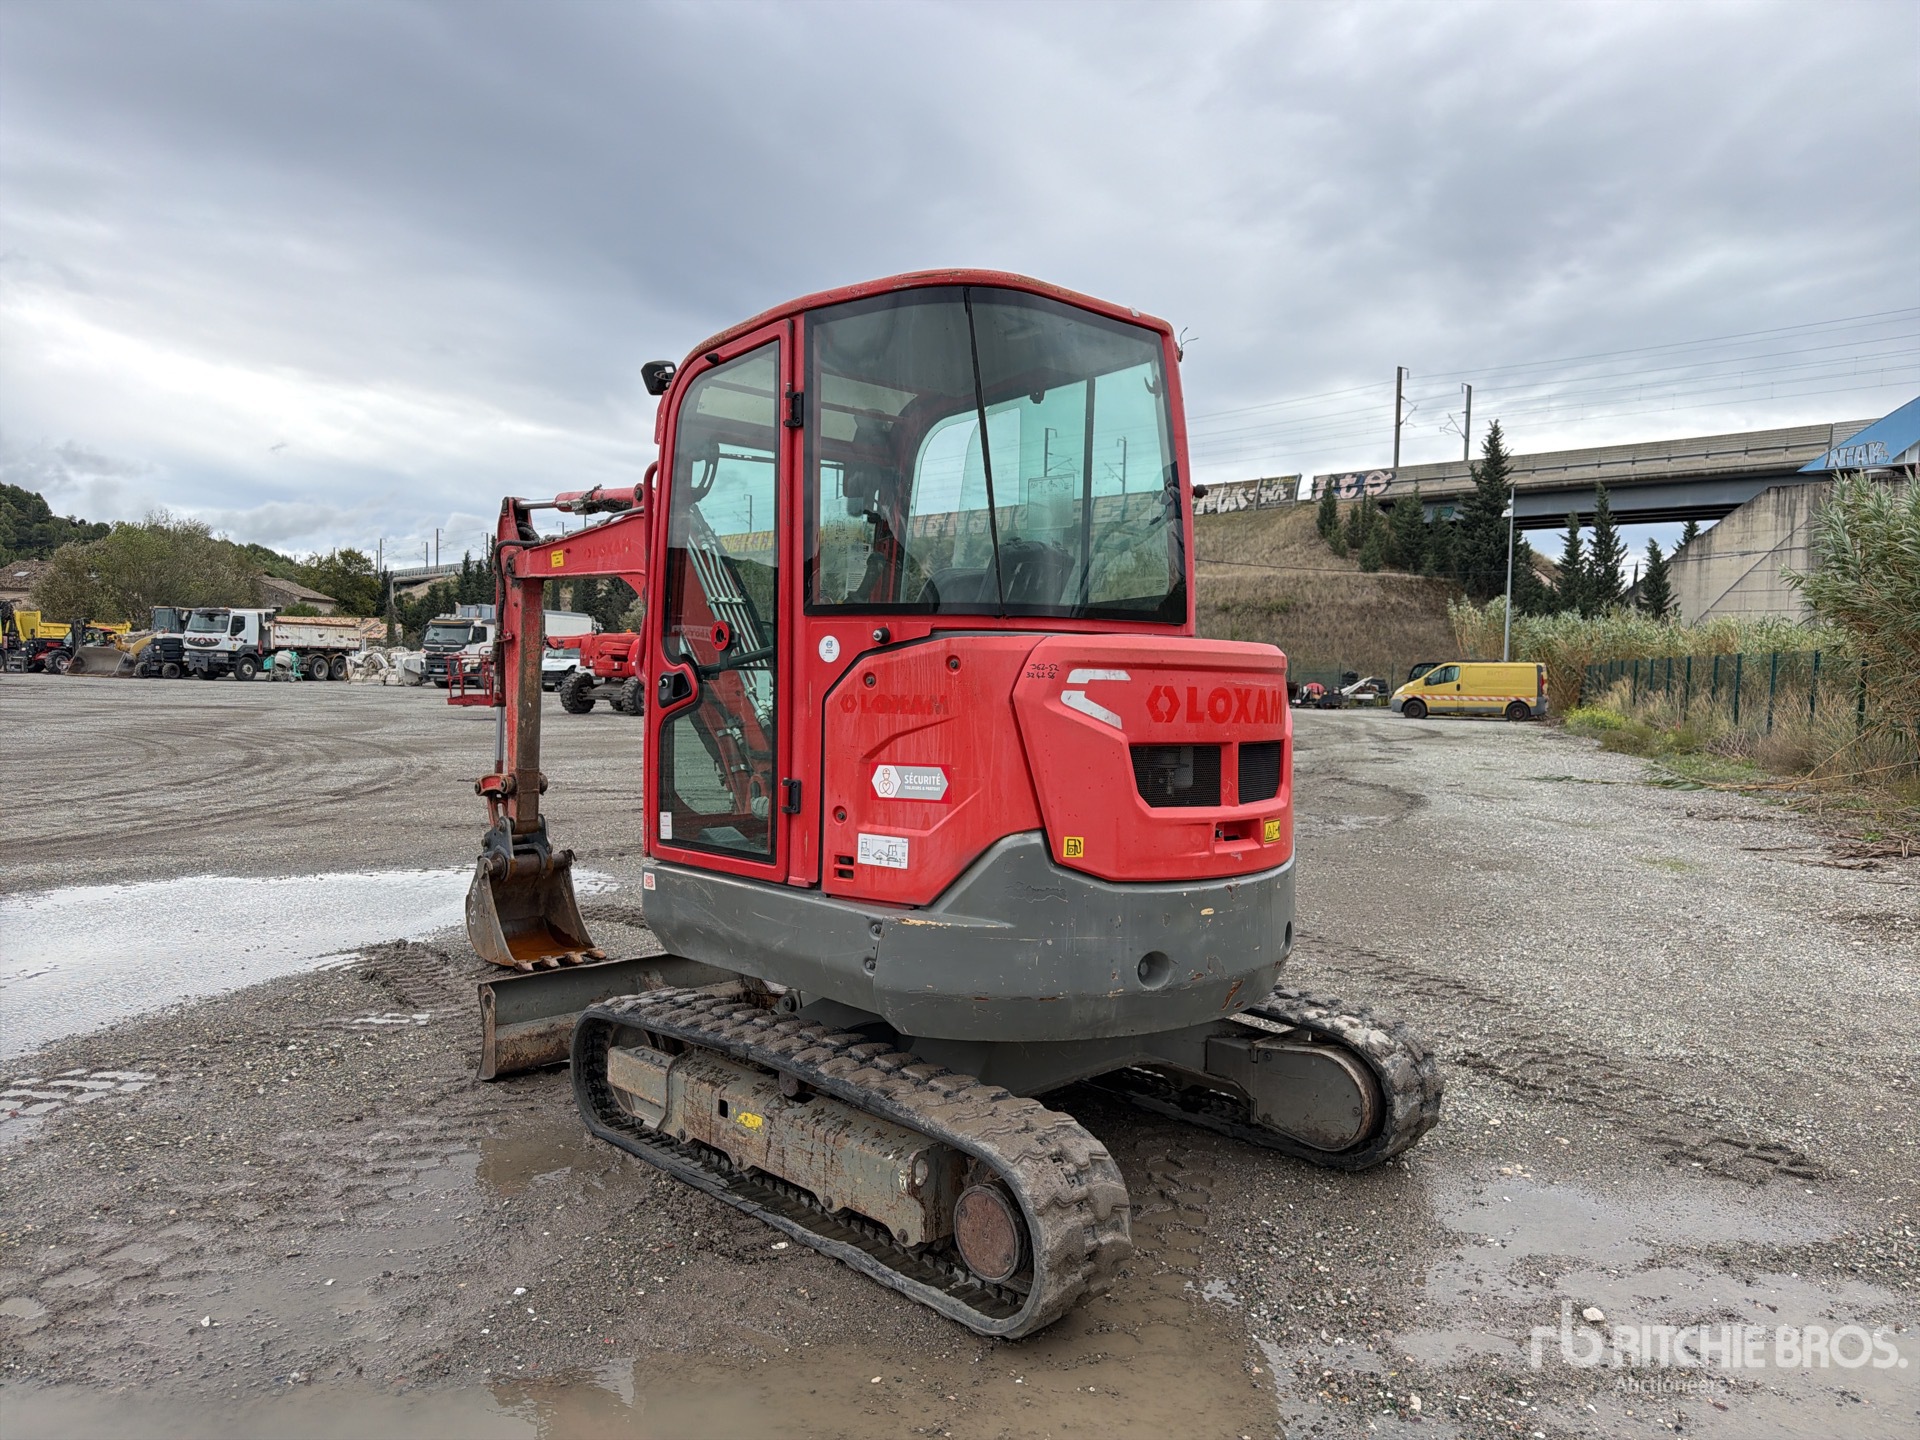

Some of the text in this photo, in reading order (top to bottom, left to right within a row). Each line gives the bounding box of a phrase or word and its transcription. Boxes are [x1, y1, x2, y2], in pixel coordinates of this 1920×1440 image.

[861, 694, 949, 715] LOXAM
[1186, 686, 1283, 724] LOXAM
[904, 772, 941, 785] SÉCURITÉ
